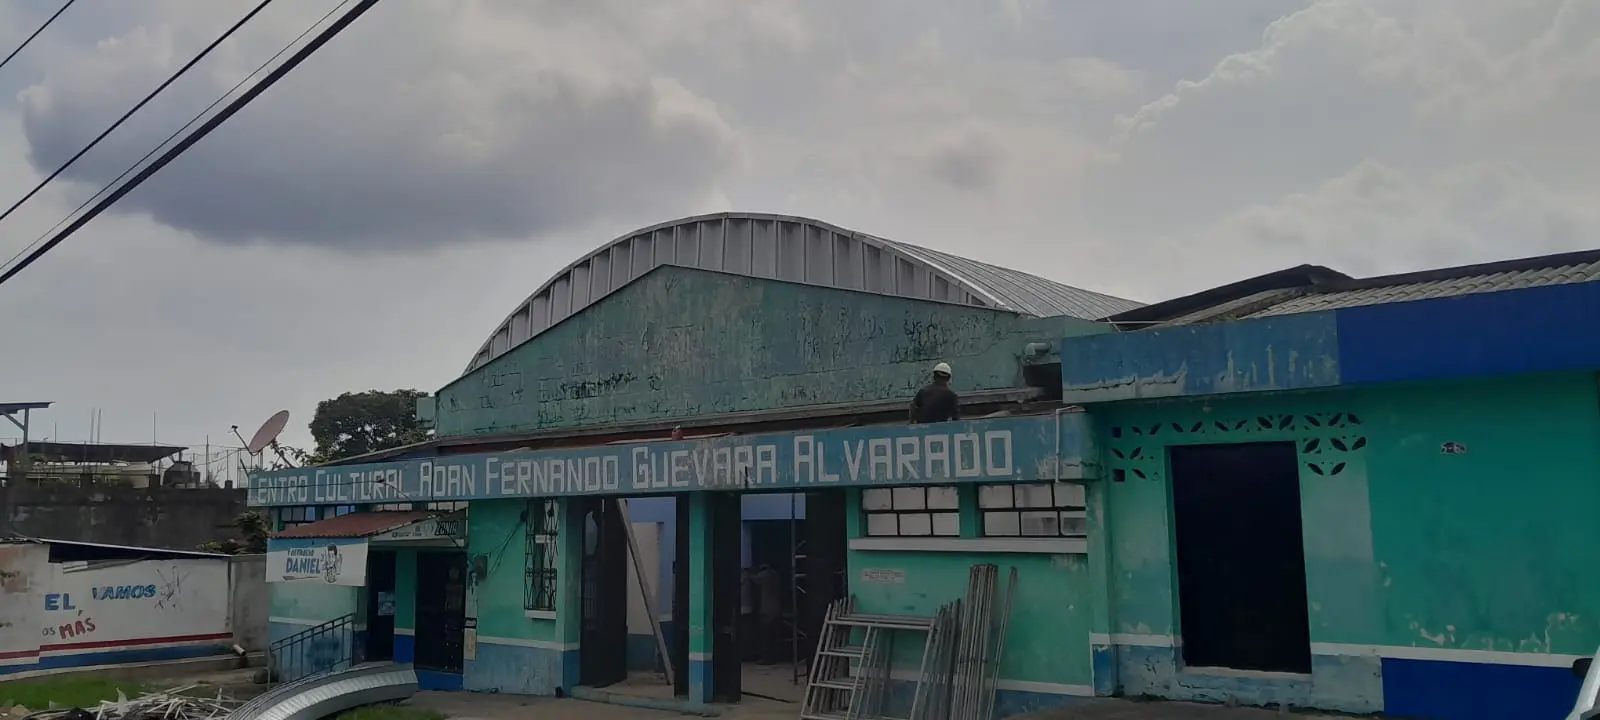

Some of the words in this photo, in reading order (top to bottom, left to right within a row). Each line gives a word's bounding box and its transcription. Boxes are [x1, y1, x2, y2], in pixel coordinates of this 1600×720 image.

[247, 474, 308, 506] CENTRO
[315, 469, 411, 501] CULTURAL
[420, 461, 475, 497] ADAN
[486, 455, 620, 495] FERNANDO
[631, 444, 776, 489] GUEVARA
[286, 558, 320, 574] DANIEL
